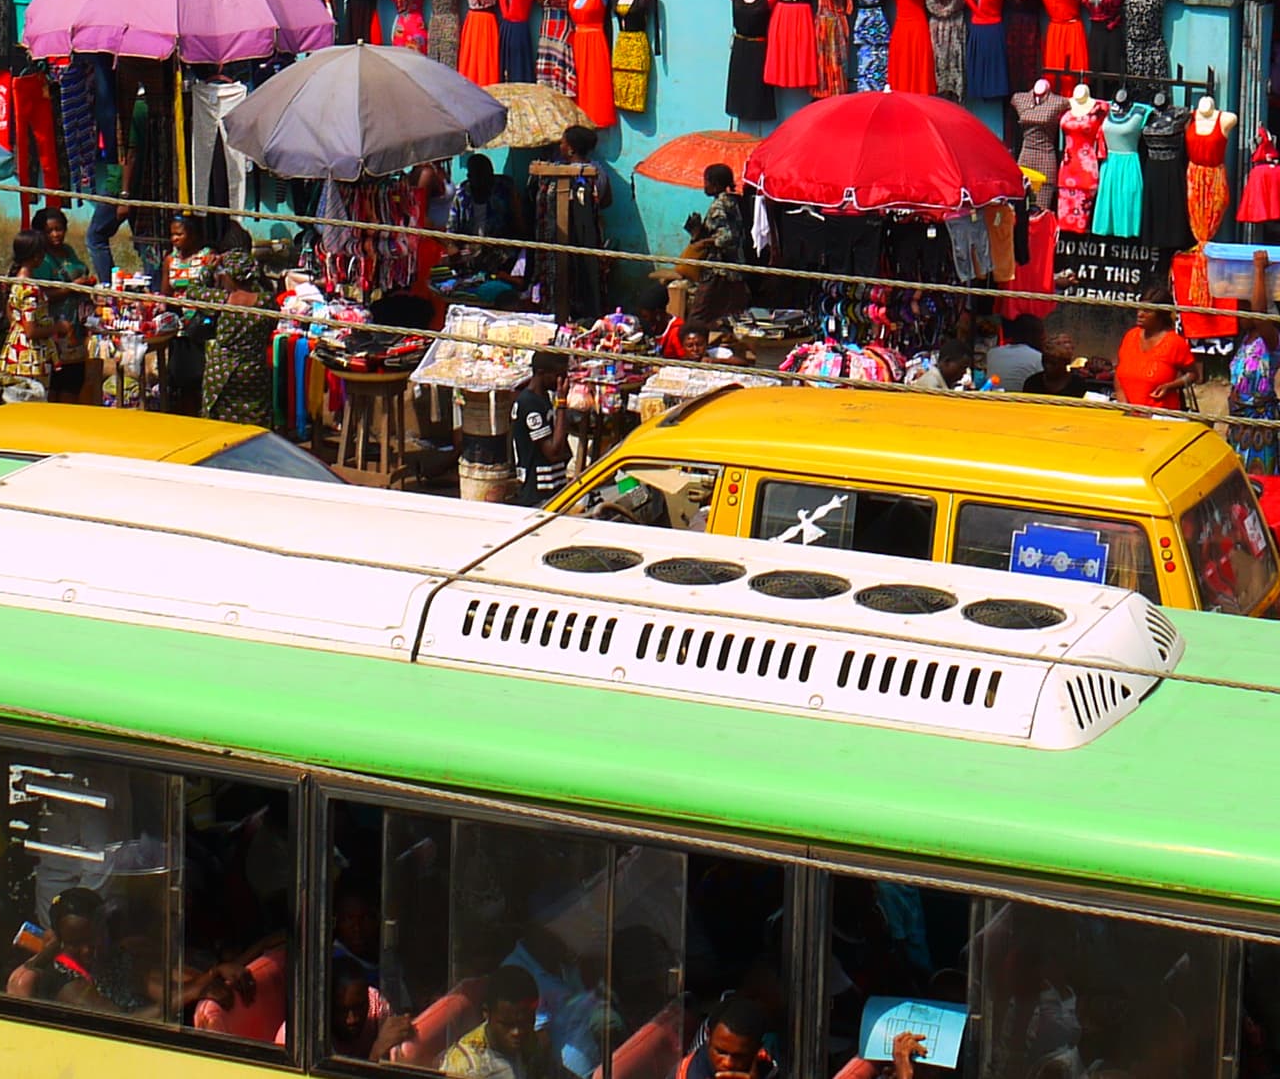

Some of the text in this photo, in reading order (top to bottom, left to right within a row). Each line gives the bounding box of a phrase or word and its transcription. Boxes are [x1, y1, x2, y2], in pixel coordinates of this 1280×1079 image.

[1056, 240, 1160, 262] DO NOT SHADE
[1078, 264, 1141, 284] AT THIS
